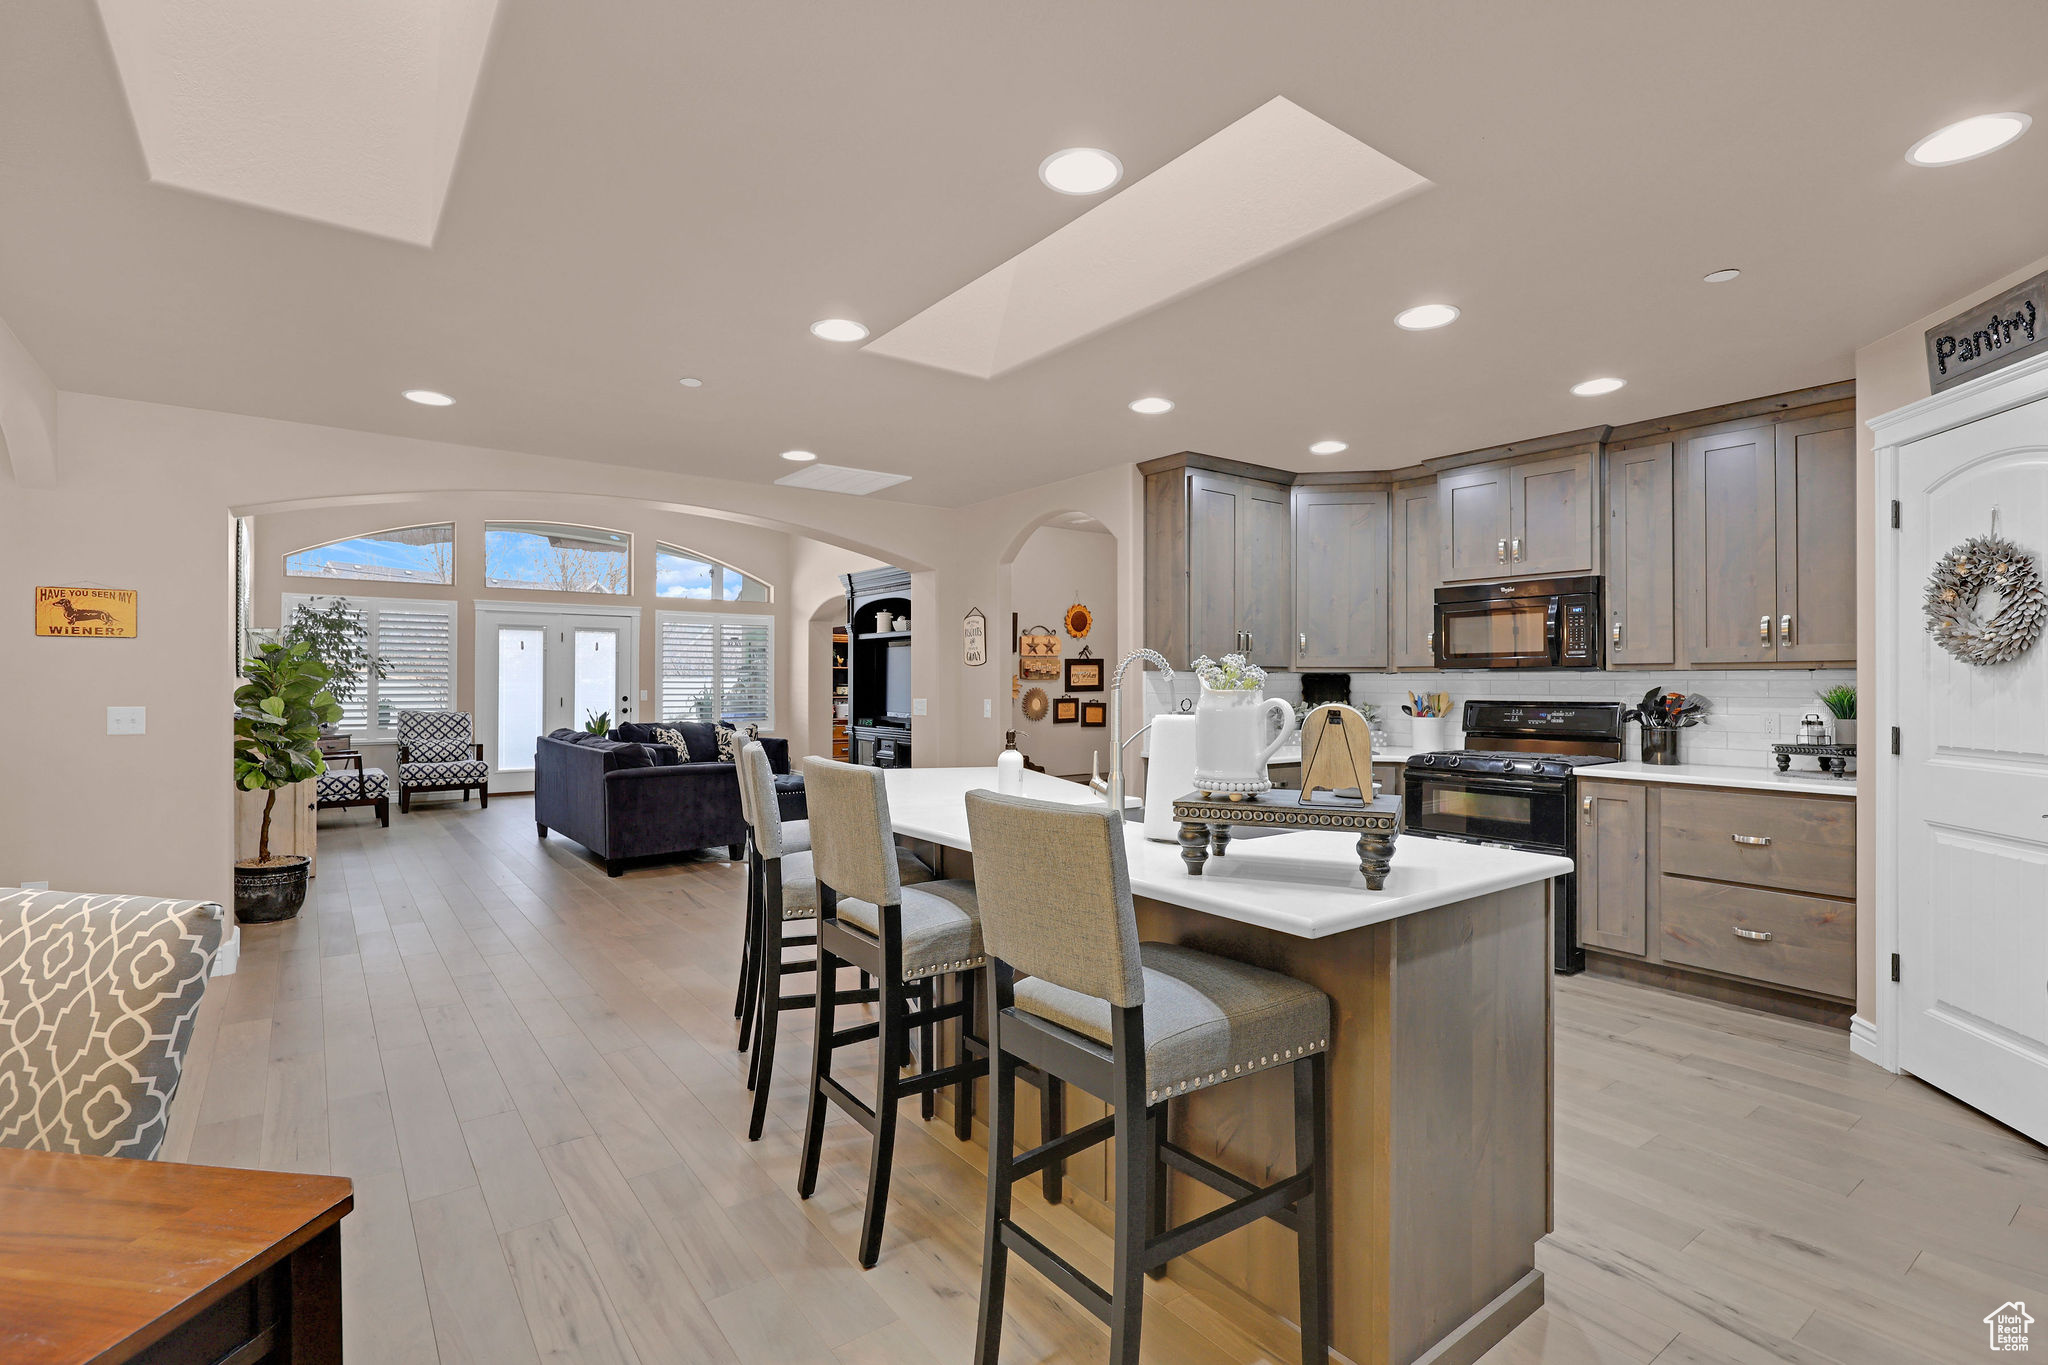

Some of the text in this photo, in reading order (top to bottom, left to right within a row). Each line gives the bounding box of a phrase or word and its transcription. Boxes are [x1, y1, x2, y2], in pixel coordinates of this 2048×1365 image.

[1936, 300, 2036, 374] Pantry
[40, 588, 133, 604] HAVE YOU SEEN MY
